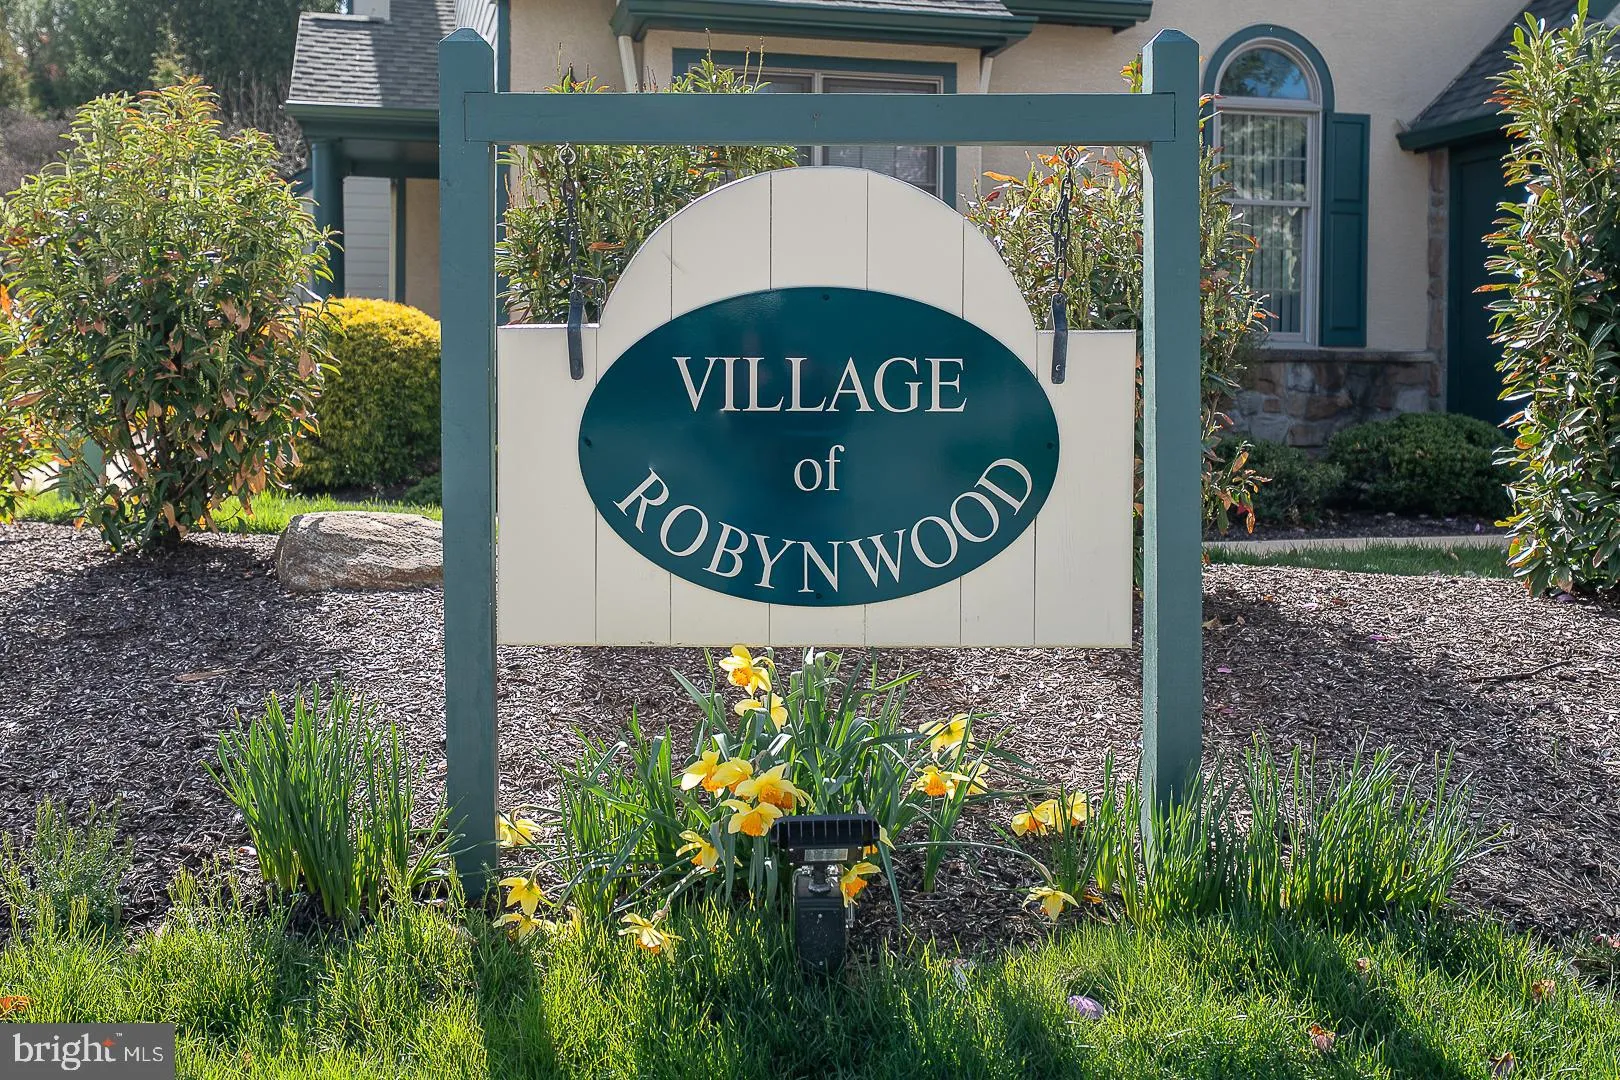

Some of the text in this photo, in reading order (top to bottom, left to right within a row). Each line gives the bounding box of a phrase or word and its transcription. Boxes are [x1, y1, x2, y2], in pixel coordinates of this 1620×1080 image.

[672, 356, 968, 413] VILLAGE
[793, 444, 845, 492] of
[613, 457, 1033, 593] ROBYNWOOD
